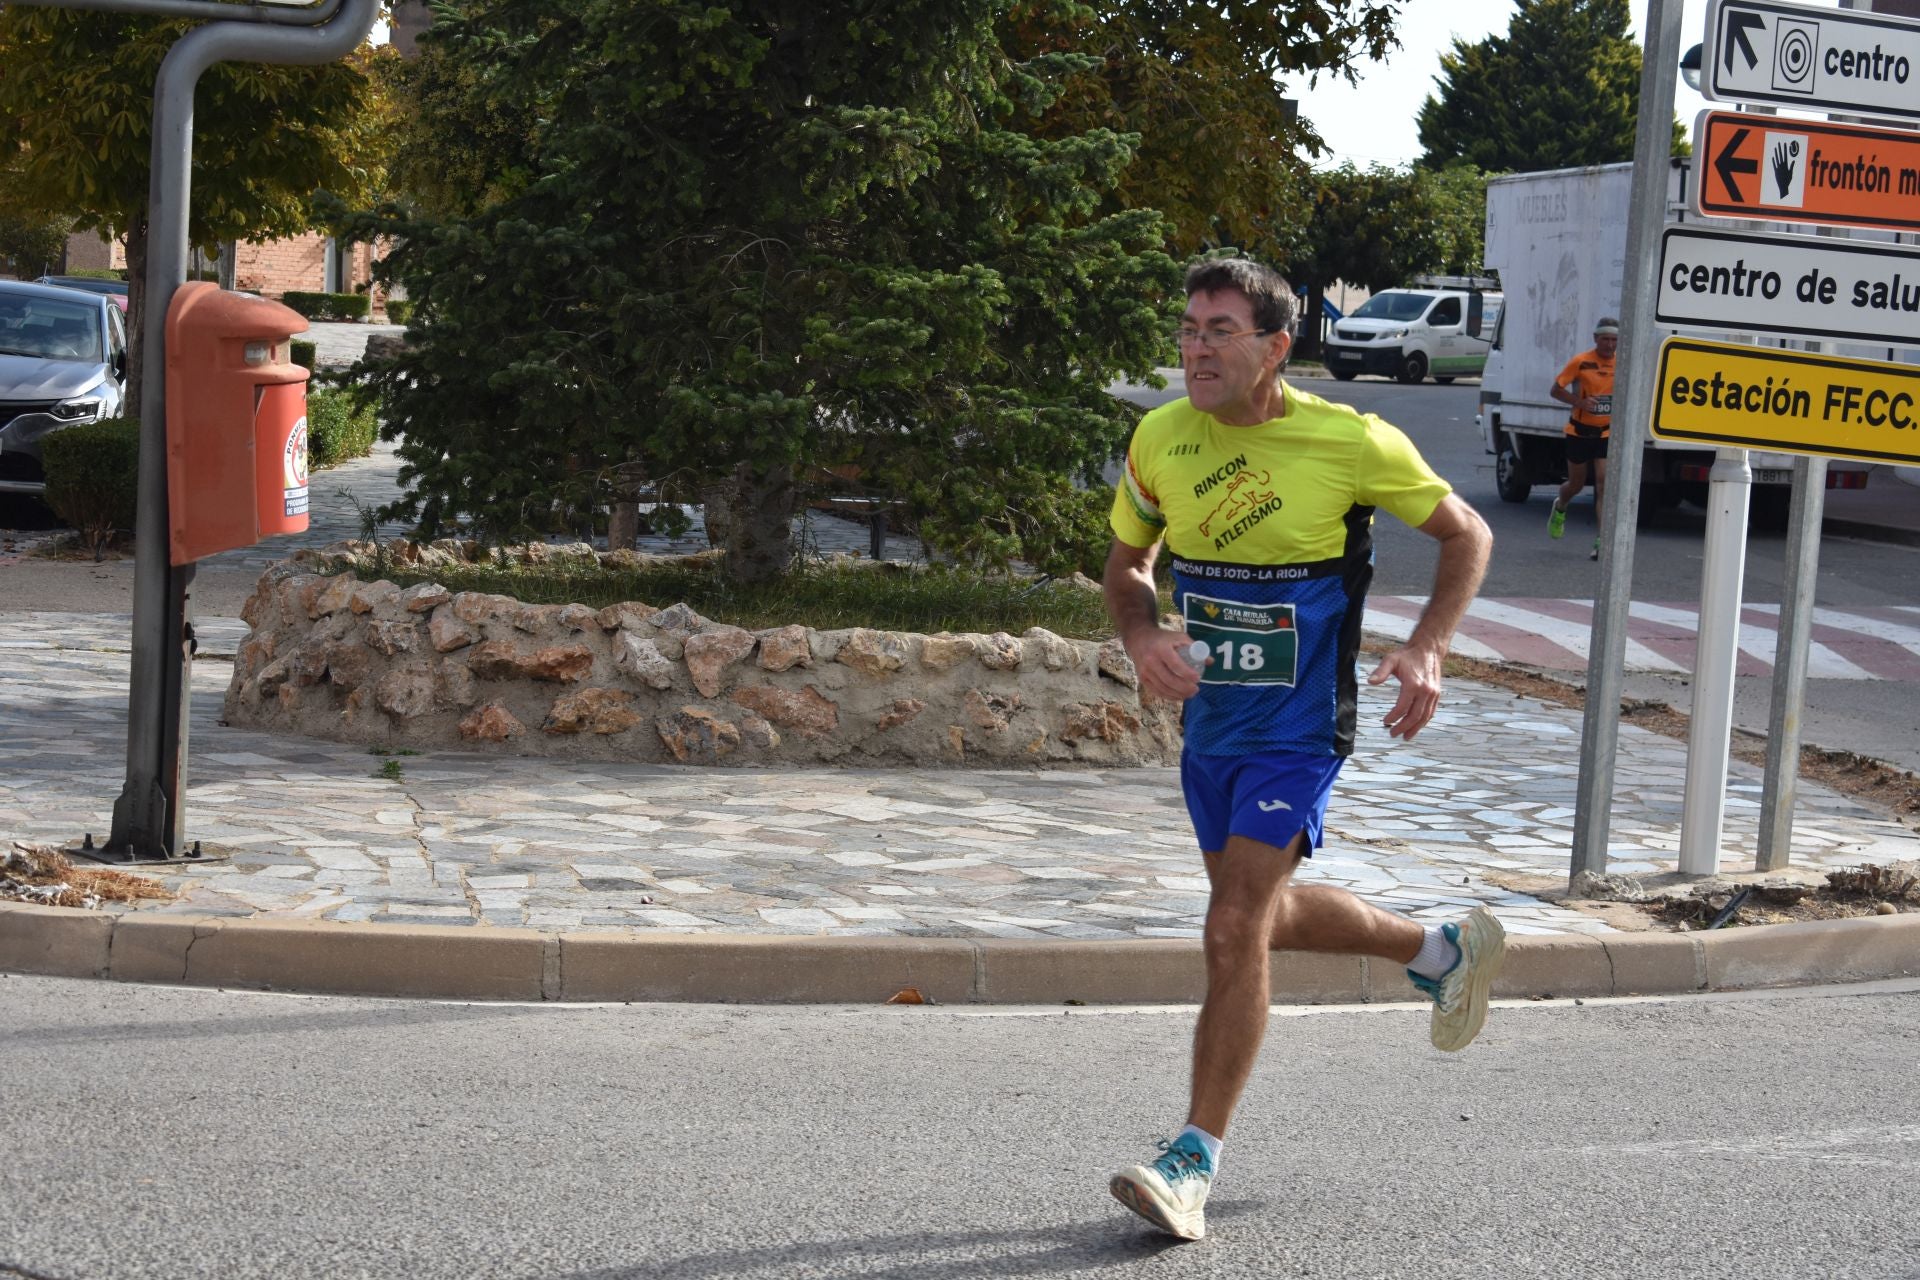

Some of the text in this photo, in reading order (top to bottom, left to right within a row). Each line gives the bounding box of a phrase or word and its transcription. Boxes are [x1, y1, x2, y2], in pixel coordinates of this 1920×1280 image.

[1824, 44, 1909, 84] centro
[1810, 150, 1920, 196] frontón m
[1515, 193, 1567, 224] MUEBLES
[1669, 259, 1781, 300] centro
[1796, 268, 1837, 305] de
[1851, 274, 1920, 313] salu
[1670, 371, 1918, 430] estación FF.CC.
[1193, 453, 1247, 498] RINCON
[1214, 497, 1282, 552] ATLETISMO
[1205, 566, 1221, 577] DE
[1223, 568, 1250, 579] SOTO
[1258, 570, 1273, 580] LA
[1276, 568, 1308, 579] RIOJA
[1216, 640, 1265, 671] 18
